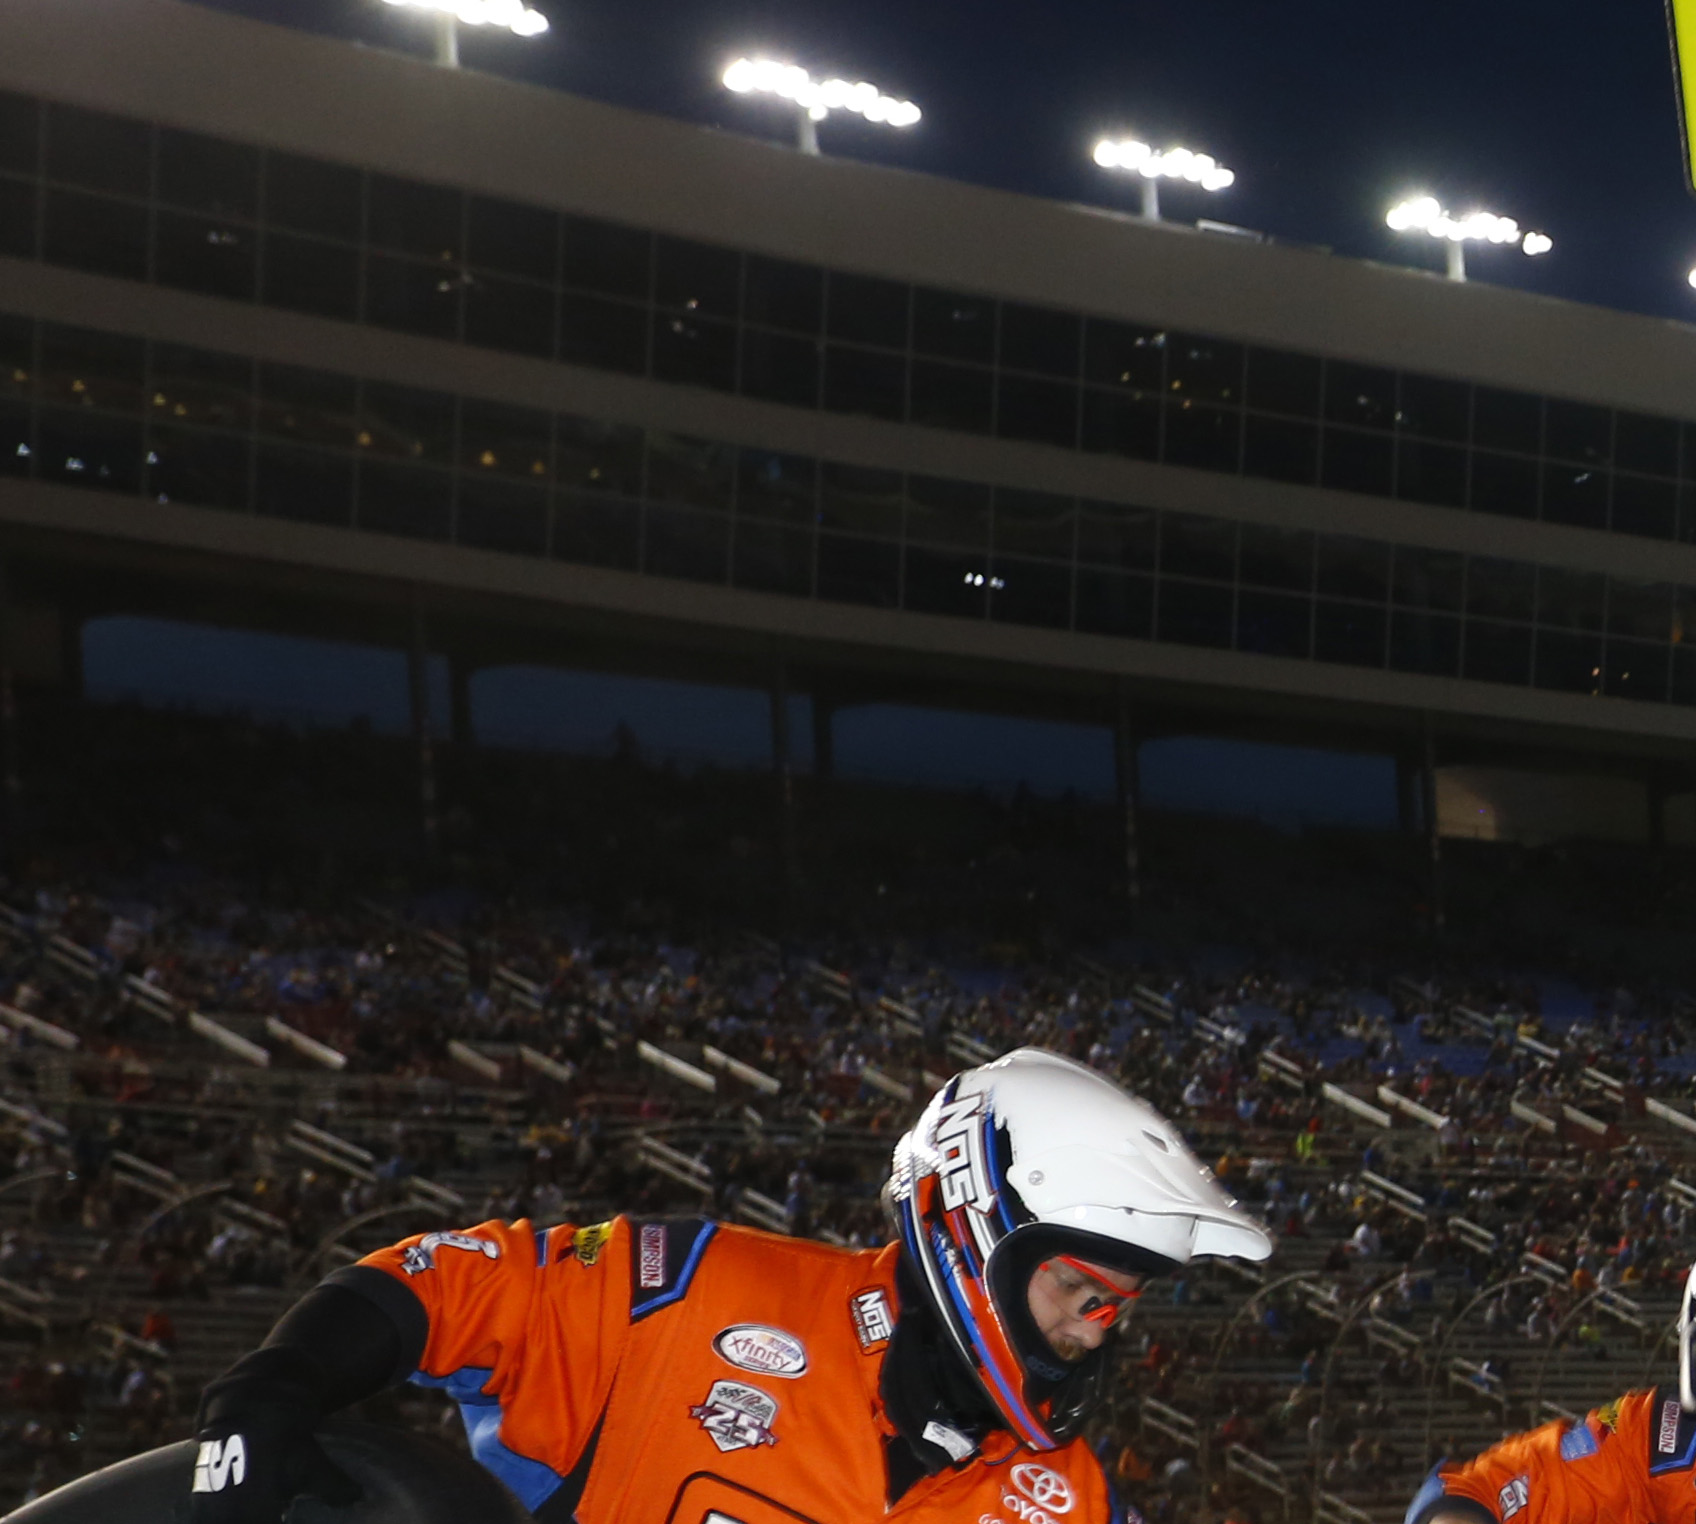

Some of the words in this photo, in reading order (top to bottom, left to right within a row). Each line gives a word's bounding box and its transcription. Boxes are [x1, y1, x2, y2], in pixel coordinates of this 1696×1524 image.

[938, 1092, 997, 1218] NOS
[641, 1225, 665, 1287] SIMPSON
[857, 1289, 893, 1343] NOS
[727, 1334, 793, 1370] xfinity
[1658, 1401, 1680, 1454] SIMPSON
